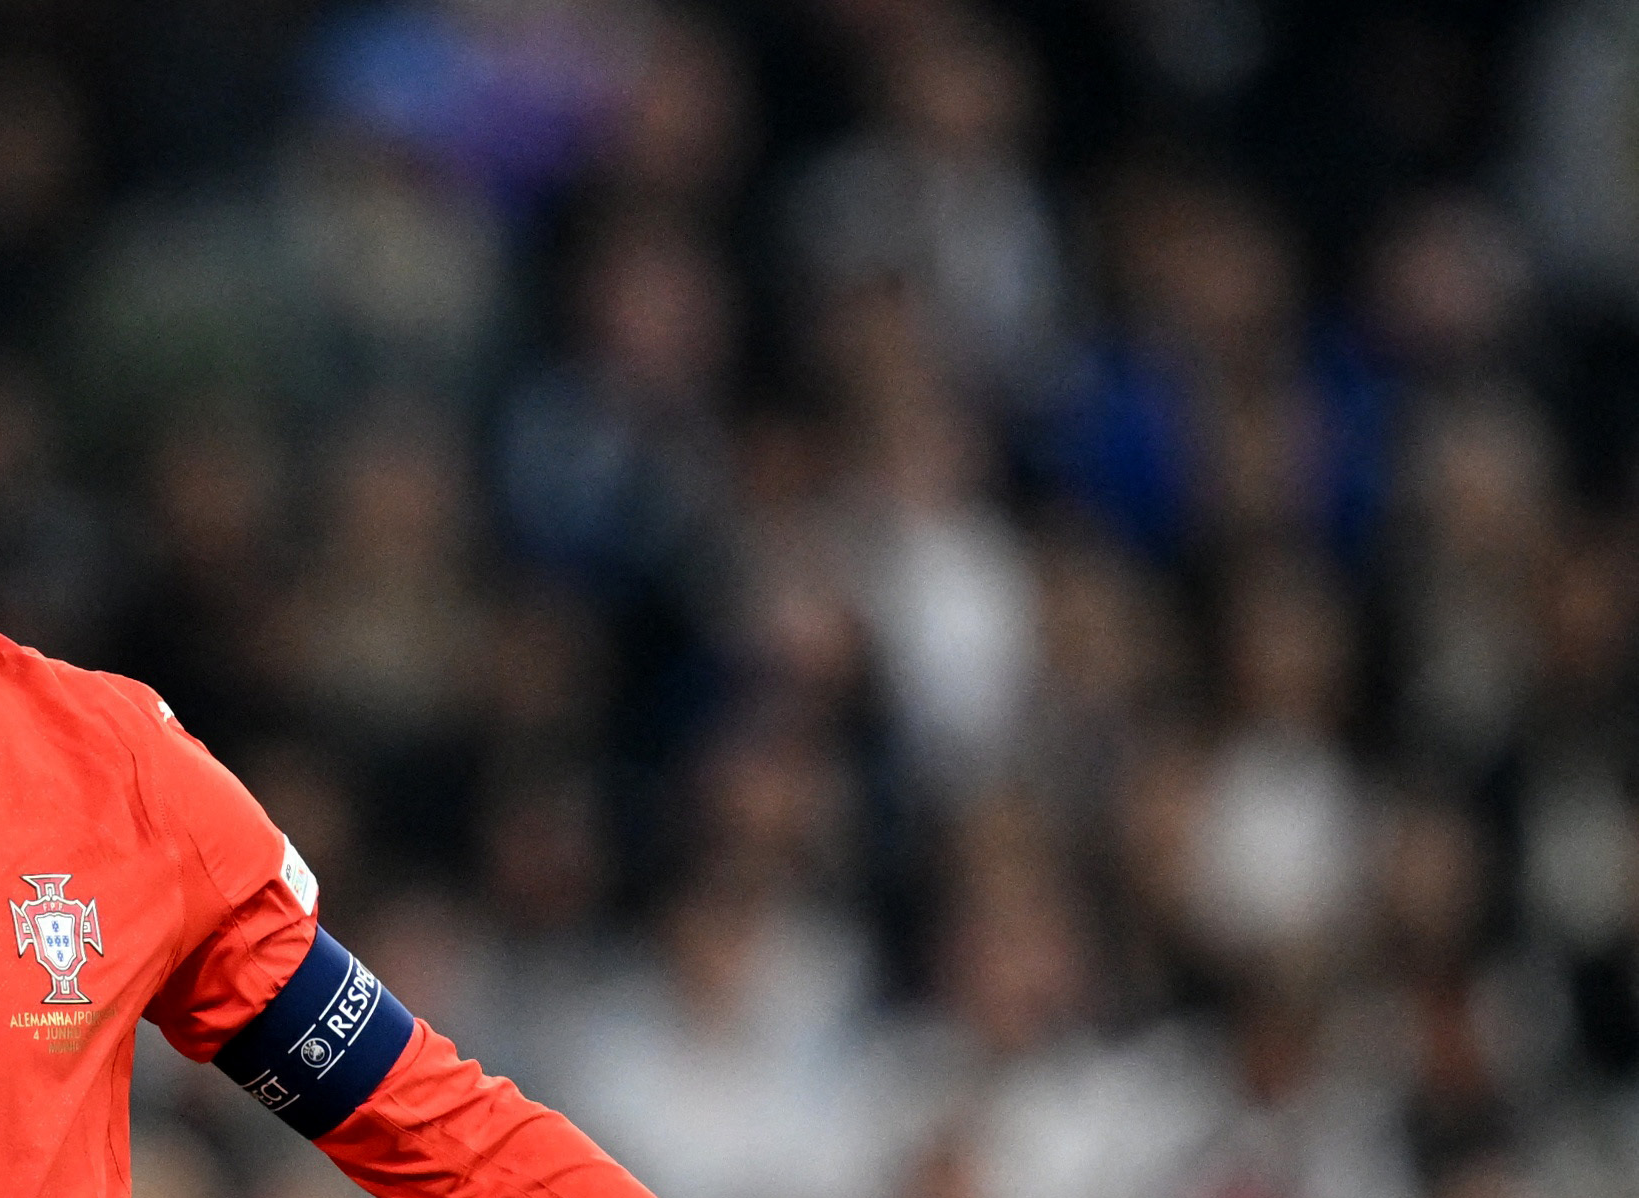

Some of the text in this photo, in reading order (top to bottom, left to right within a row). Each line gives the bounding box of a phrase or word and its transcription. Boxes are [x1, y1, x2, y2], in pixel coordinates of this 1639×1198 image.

[327, 957, 375, 1039] RESPE
[33, 1027, 82, 1040] 4 JUNHO
